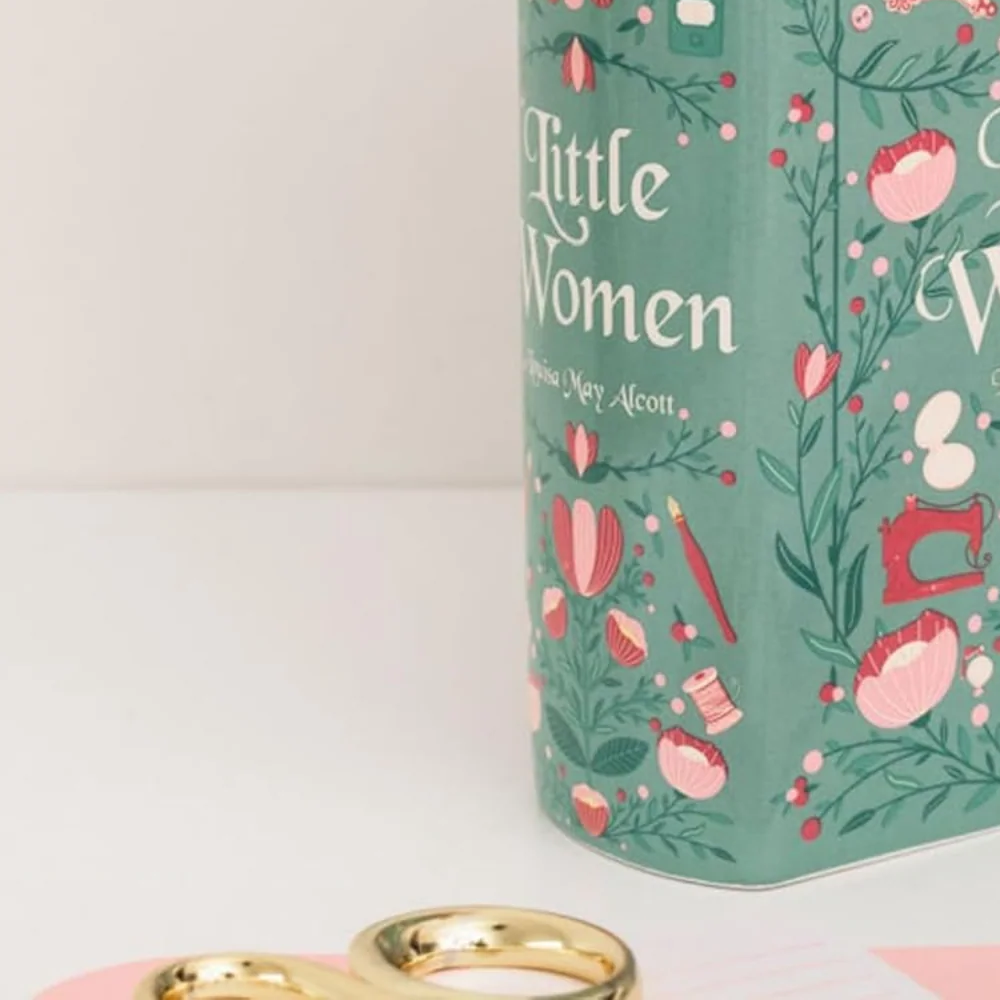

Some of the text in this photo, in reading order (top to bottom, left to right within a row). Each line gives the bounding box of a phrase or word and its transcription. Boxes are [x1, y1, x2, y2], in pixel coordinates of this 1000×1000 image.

[524, 106, 670, 246] Little
[562, 367, 605, 415] May
[608, 383, 674, 418] Alcott
